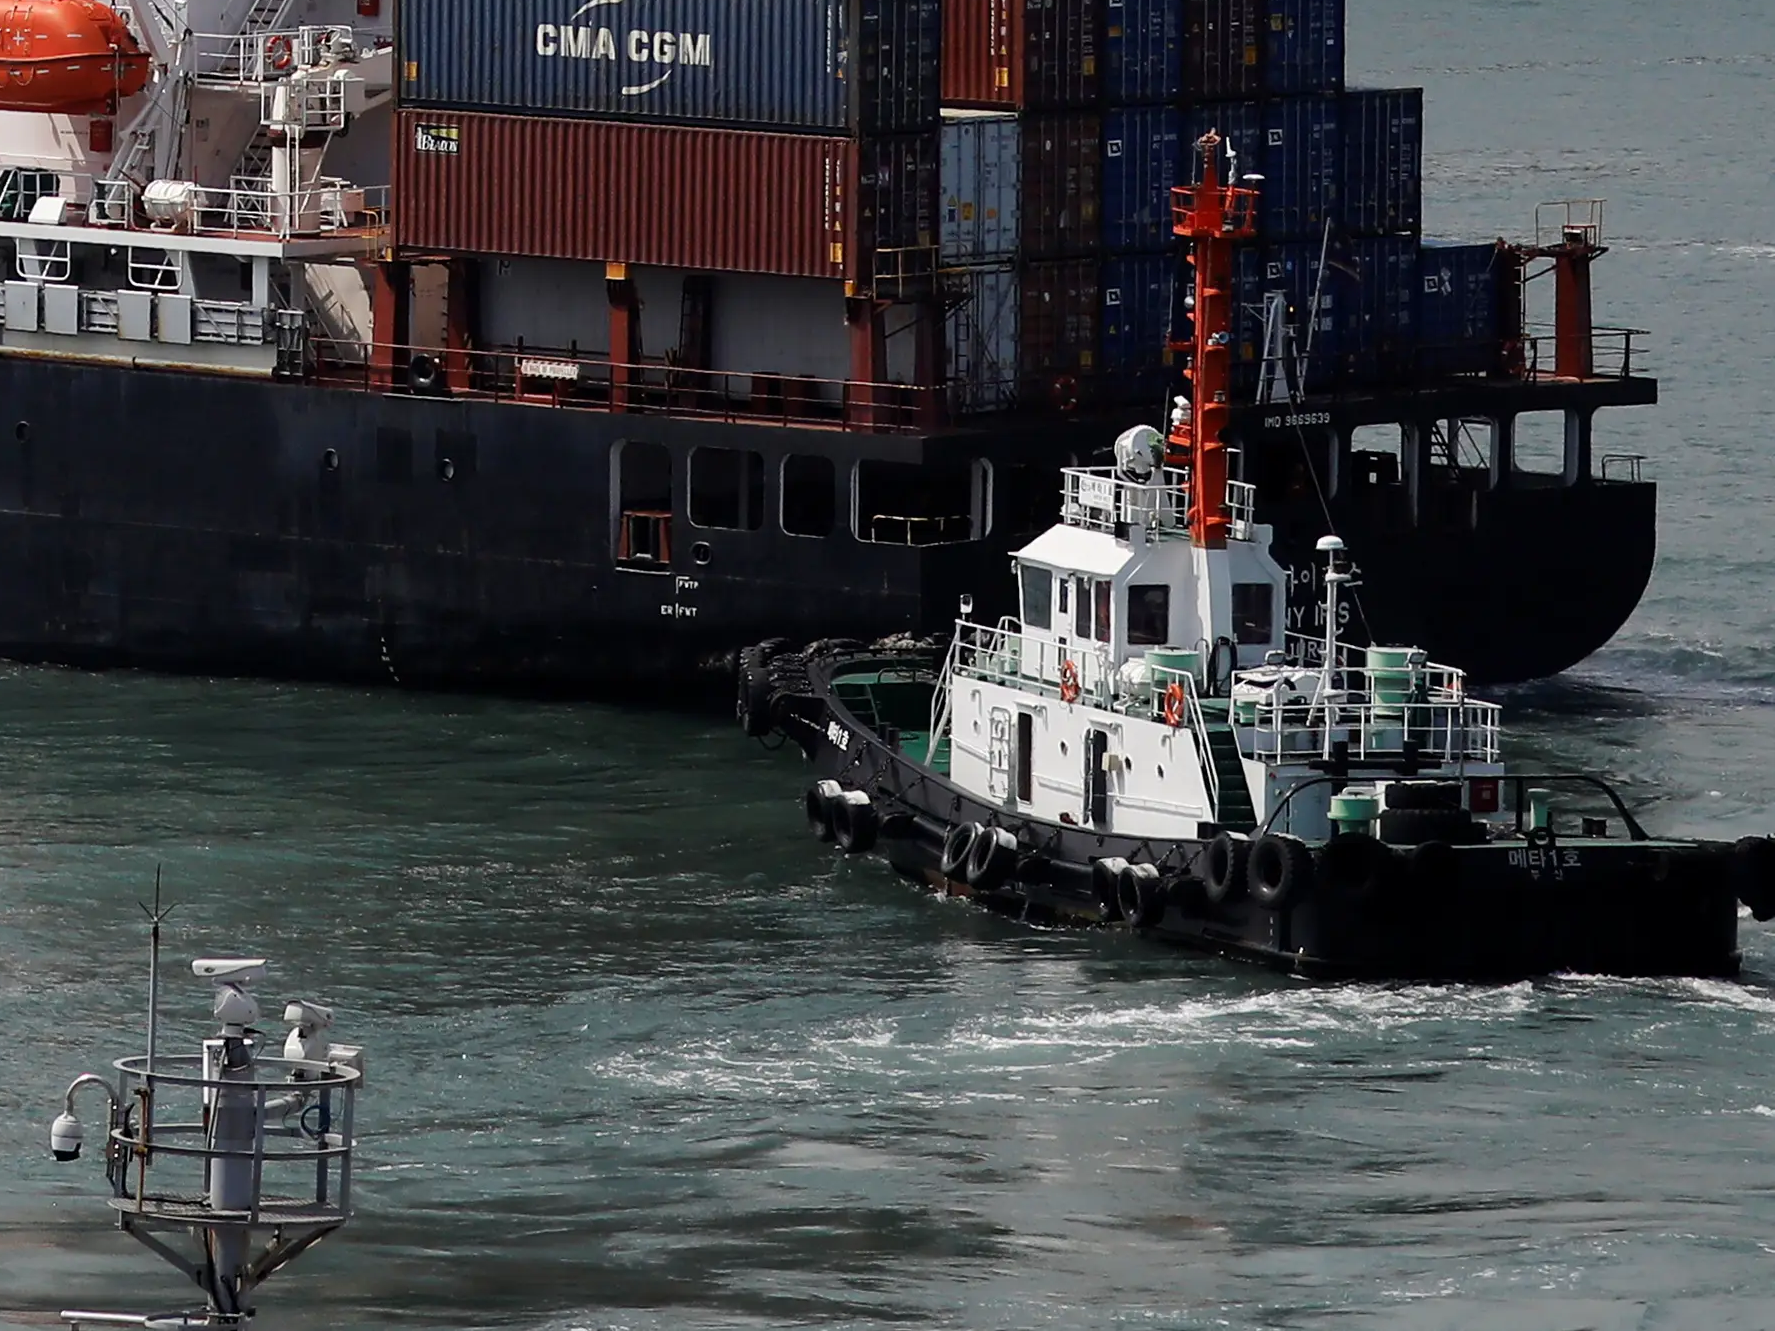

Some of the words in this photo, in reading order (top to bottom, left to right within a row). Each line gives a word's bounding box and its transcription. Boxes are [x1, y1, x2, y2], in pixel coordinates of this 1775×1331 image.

[537, 23, 616, 61] CMA
[627, 29, 711, 67] CGM
[1264, 416, 1281, 428] IMO
[1508, 848, 1582, 869] 메타1호
